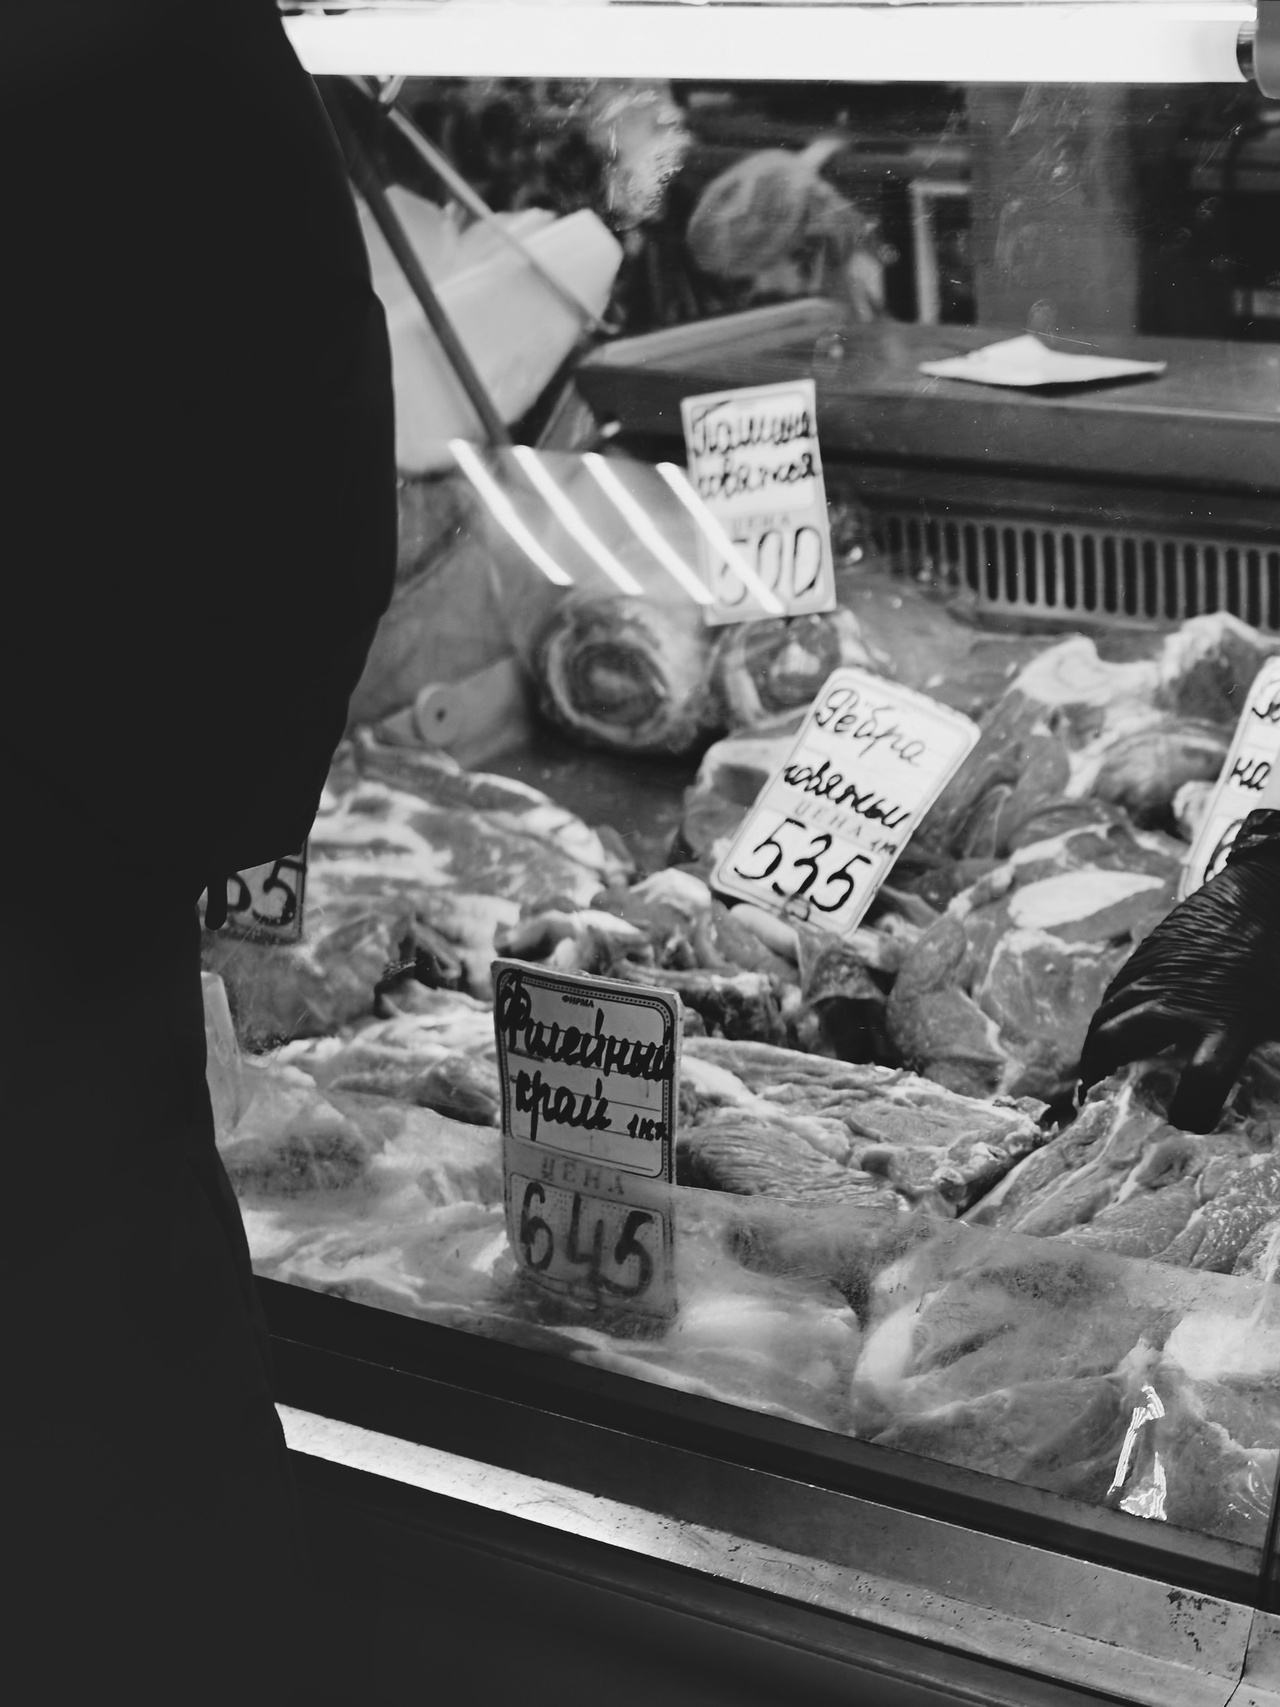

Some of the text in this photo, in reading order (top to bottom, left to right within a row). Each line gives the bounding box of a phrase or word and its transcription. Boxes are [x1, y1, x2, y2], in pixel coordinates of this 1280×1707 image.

[733, 816, 873, 913] 535
[516, 1069, 612, 1142] край
[541, 1156, 625, 1196] ЦЕНА
[520, 1181, 654, 1297] 645
